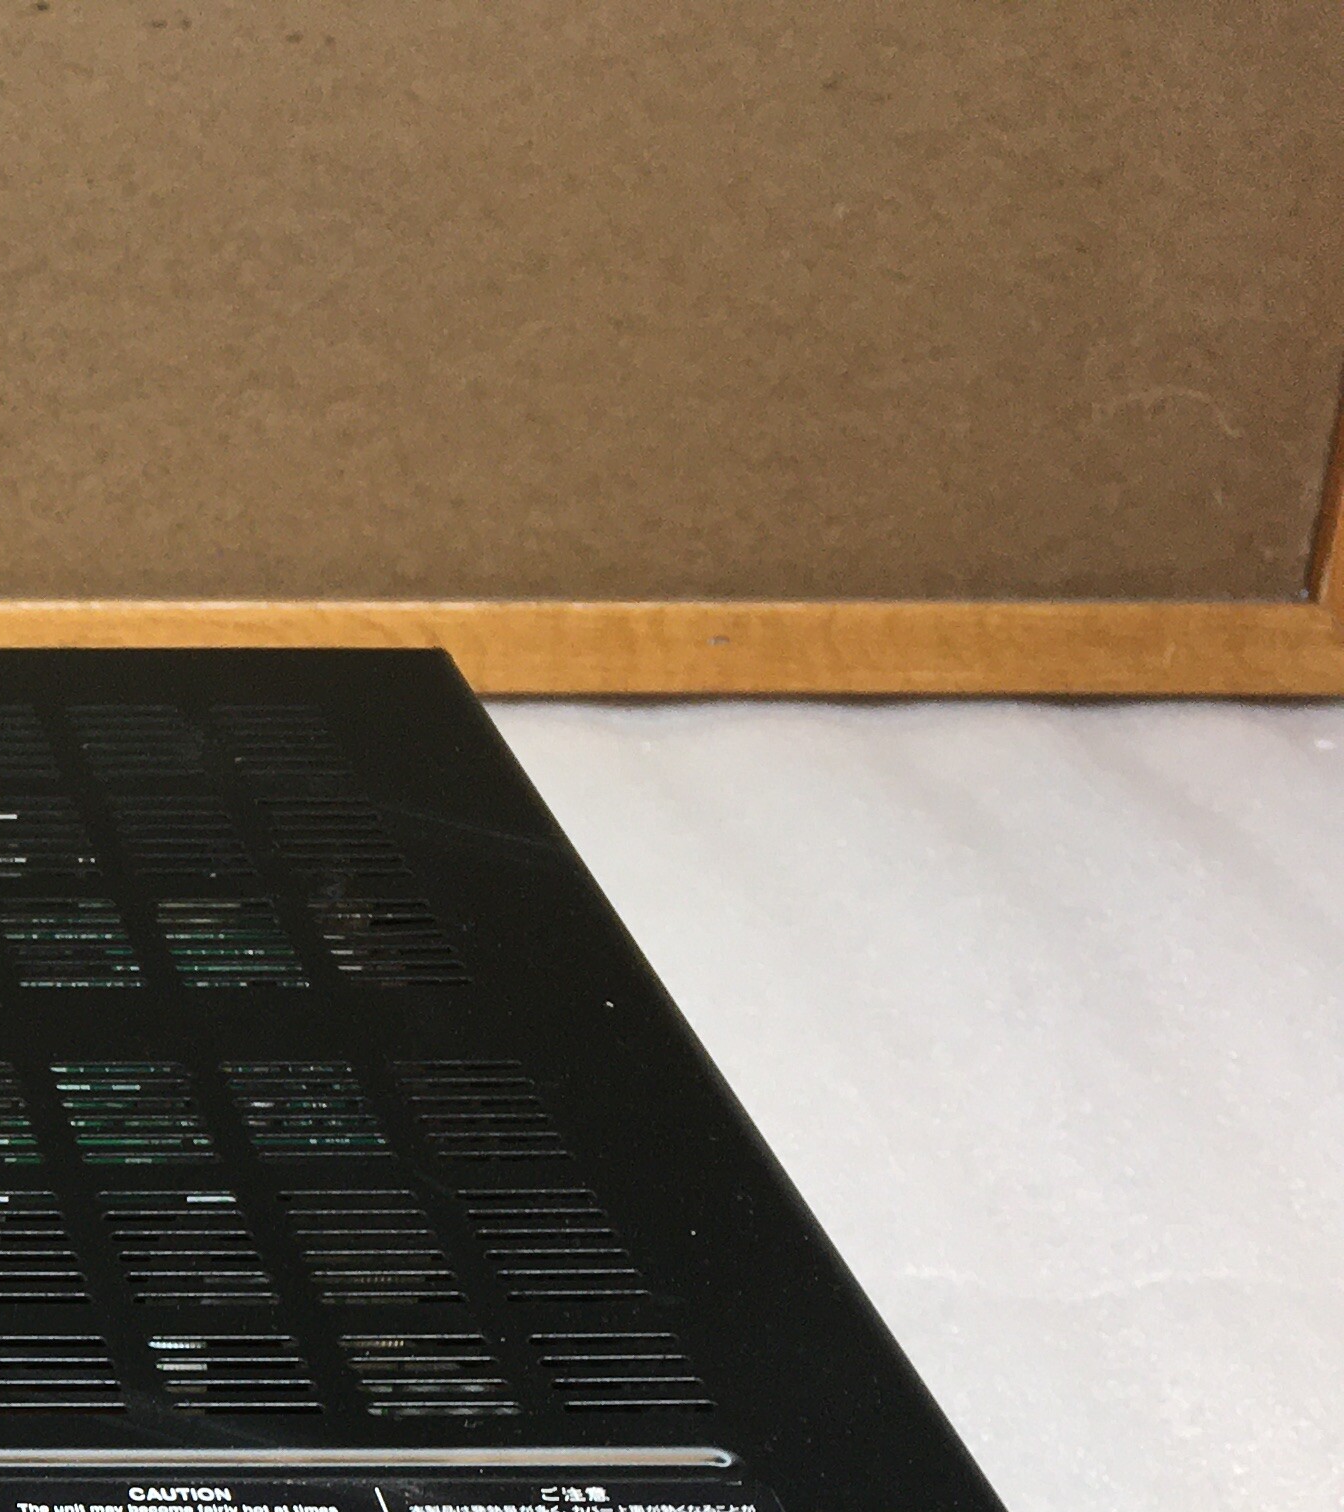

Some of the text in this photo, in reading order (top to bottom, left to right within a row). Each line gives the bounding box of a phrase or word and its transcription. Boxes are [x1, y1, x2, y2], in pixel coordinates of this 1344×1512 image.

[128, 1487, 232, 1502] CAUTION
[540, 1486, 610, 1502] ご注意
